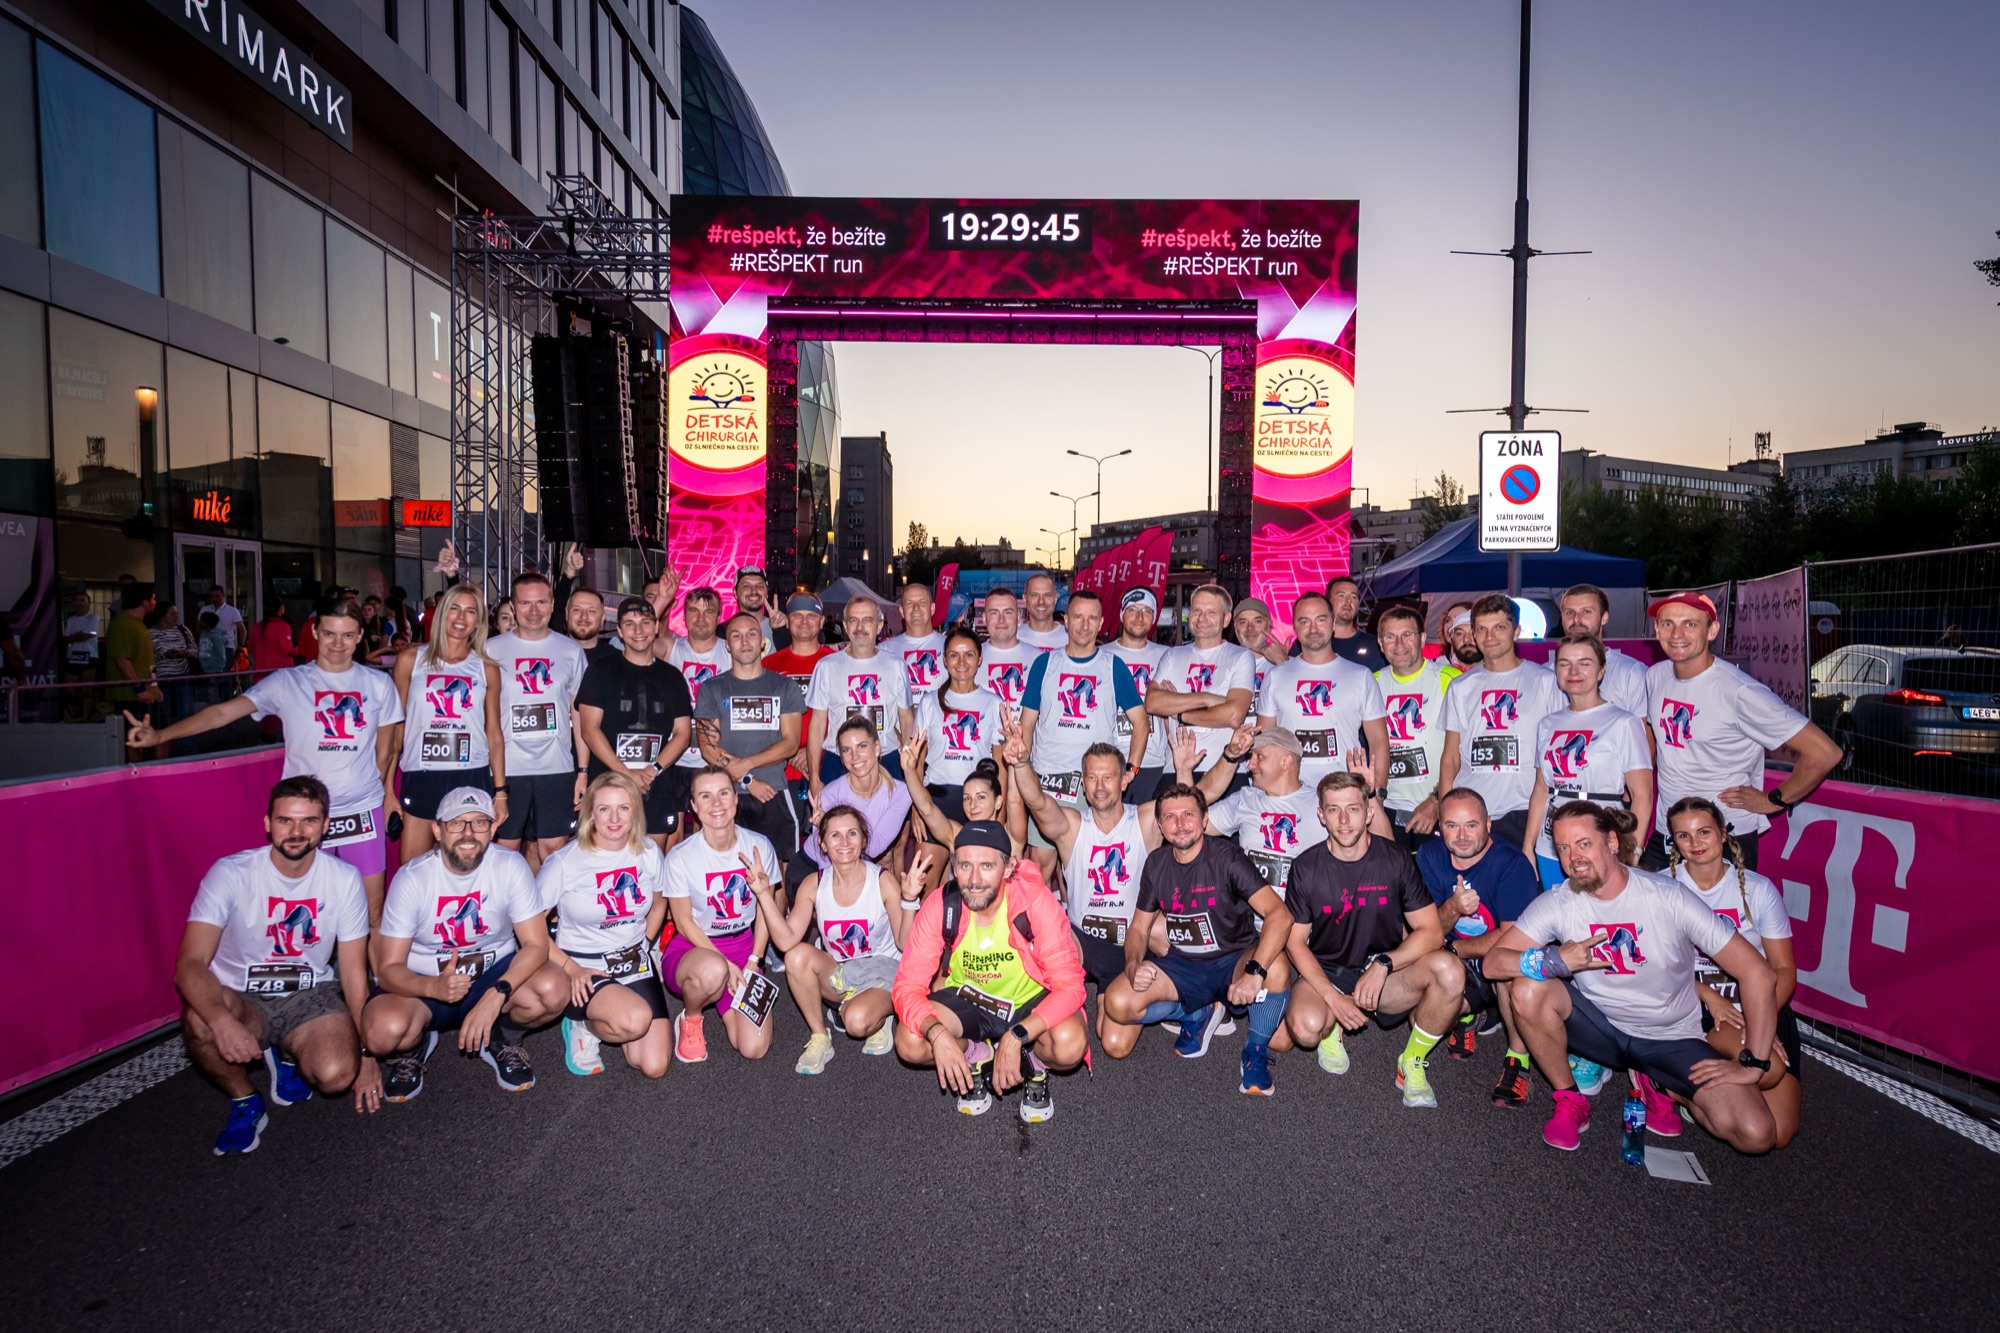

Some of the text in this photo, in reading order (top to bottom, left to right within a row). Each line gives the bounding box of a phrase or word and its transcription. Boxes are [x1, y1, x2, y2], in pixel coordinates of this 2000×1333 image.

[942, 212, 1080, 241] 19:29:45
[707, 224, 886, 248] #rešpekt, že bežíte
[1141, 228, 1322, 251] #rešpekt, že bežíte
[729, 249, 863, 273] #REŠPEKT run
[1163, 252, 1298, 276] #REŠPEKT run
[685, 412, 758, 430] DETSKÁ
[1258, 417, 1332, 435] DETSKÁ
[685, 430, 758, 443] CHIRURGIA
[1257, 437, 1332, 449] CHIRURGIA
[1497, 436, 1543, 456] ZÓNA
[193, 491, 231, 523] niké
[413, 506, 444, 522] niké
[1148, 561, 1166, 587] T
[941, 575, 953, 590] T
[733, 707, 763, 719] 3345
[513, 715, 538, 728] 568
[423, 744, 450, 757] 500
[619, 746, 643, 758] 633
[1300, 741, 1320, 753] 46
[1472, 747, 1493, 761] 153
[328, 818, 356, 835] 550
[1781, 802, 1915, 1009] T
[711, 923, 732, 931] NIGHT
[1083, 925, 1107, 939] 503
[1168, 928, 1193, 941] 454
[963, 950, 1014, 964] RUNNING
[963, 960, 999, 972] PARTY
[248, 980, 285, 992] 548
[748, 977, 767, 1007] 4124
